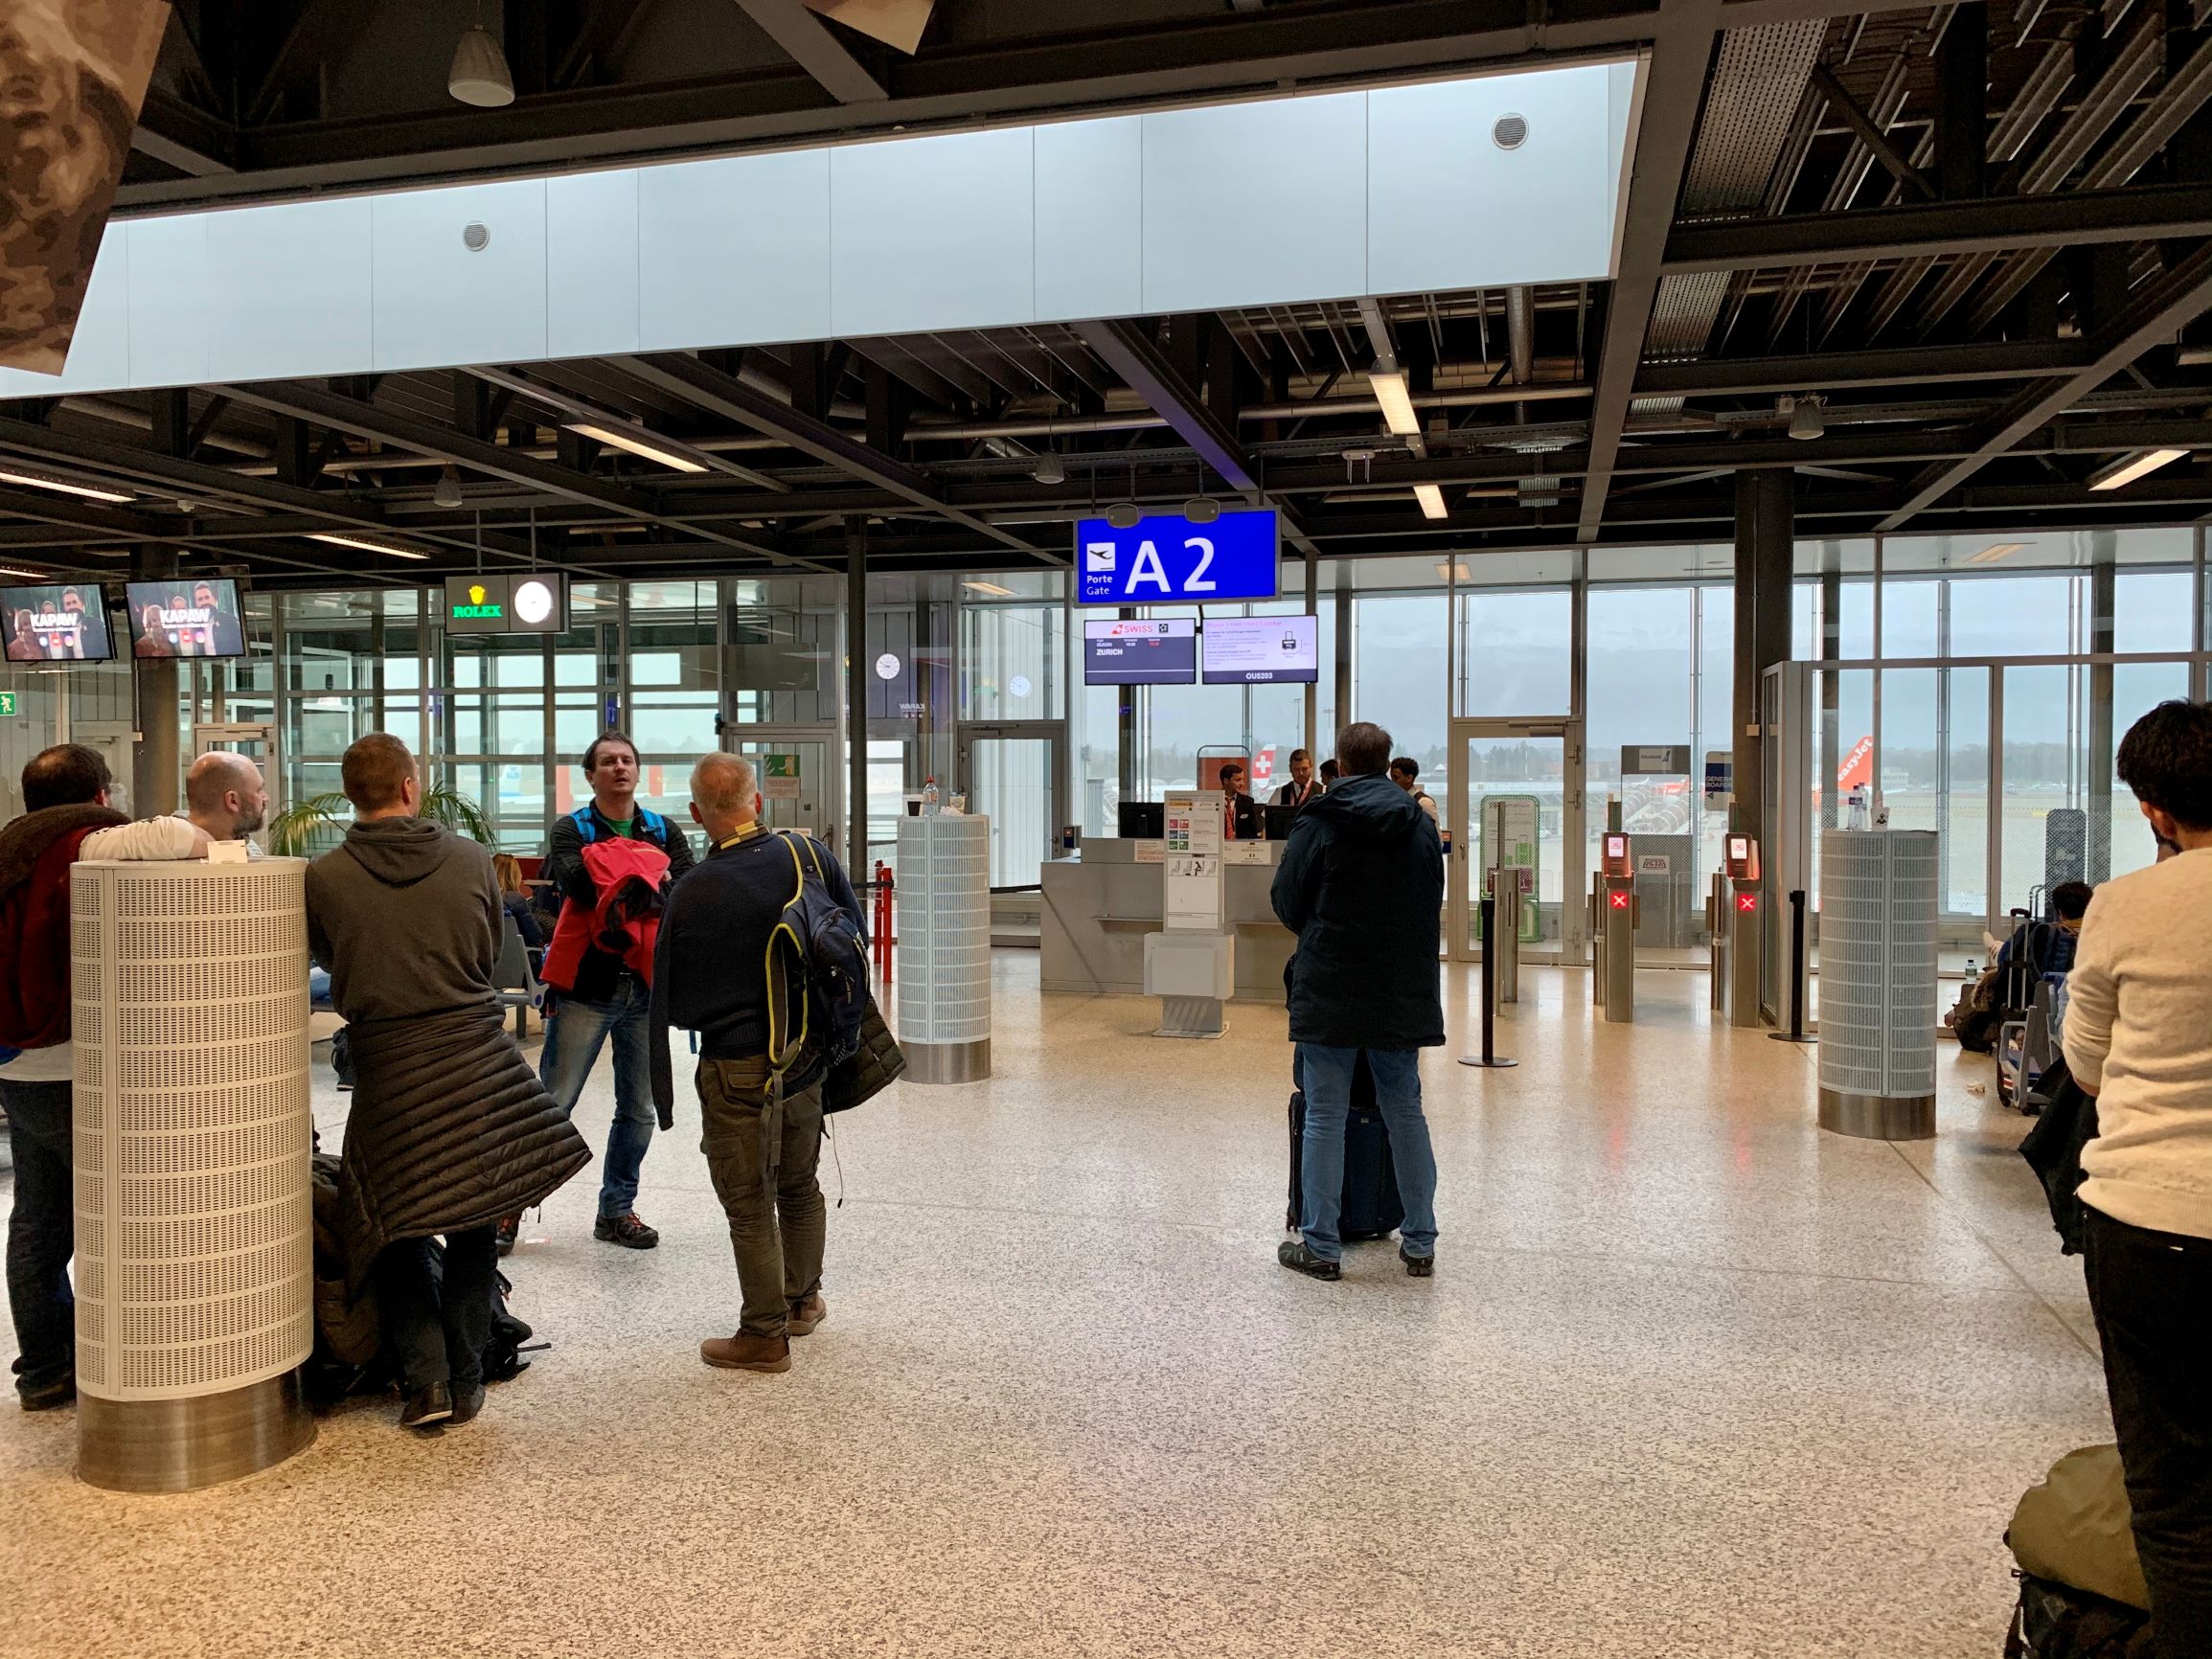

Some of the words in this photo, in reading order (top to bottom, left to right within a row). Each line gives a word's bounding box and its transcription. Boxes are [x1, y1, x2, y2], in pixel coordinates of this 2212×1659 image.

[1124, 540, 1172, 594] A
[1183, 537, 1216, 592] 2
[1086, 575, 1113, 583] Porte
[1086, 586, 1109, 596] Gate
[159, 608, 210, 624] KAPAW
[452, 604, 503, 619] ROLEX
[30, 613, 78, 627] KAPAW
[1124, 625, 1153, 633] SWISS
[1838, 738, 1874, 782] easyJet
